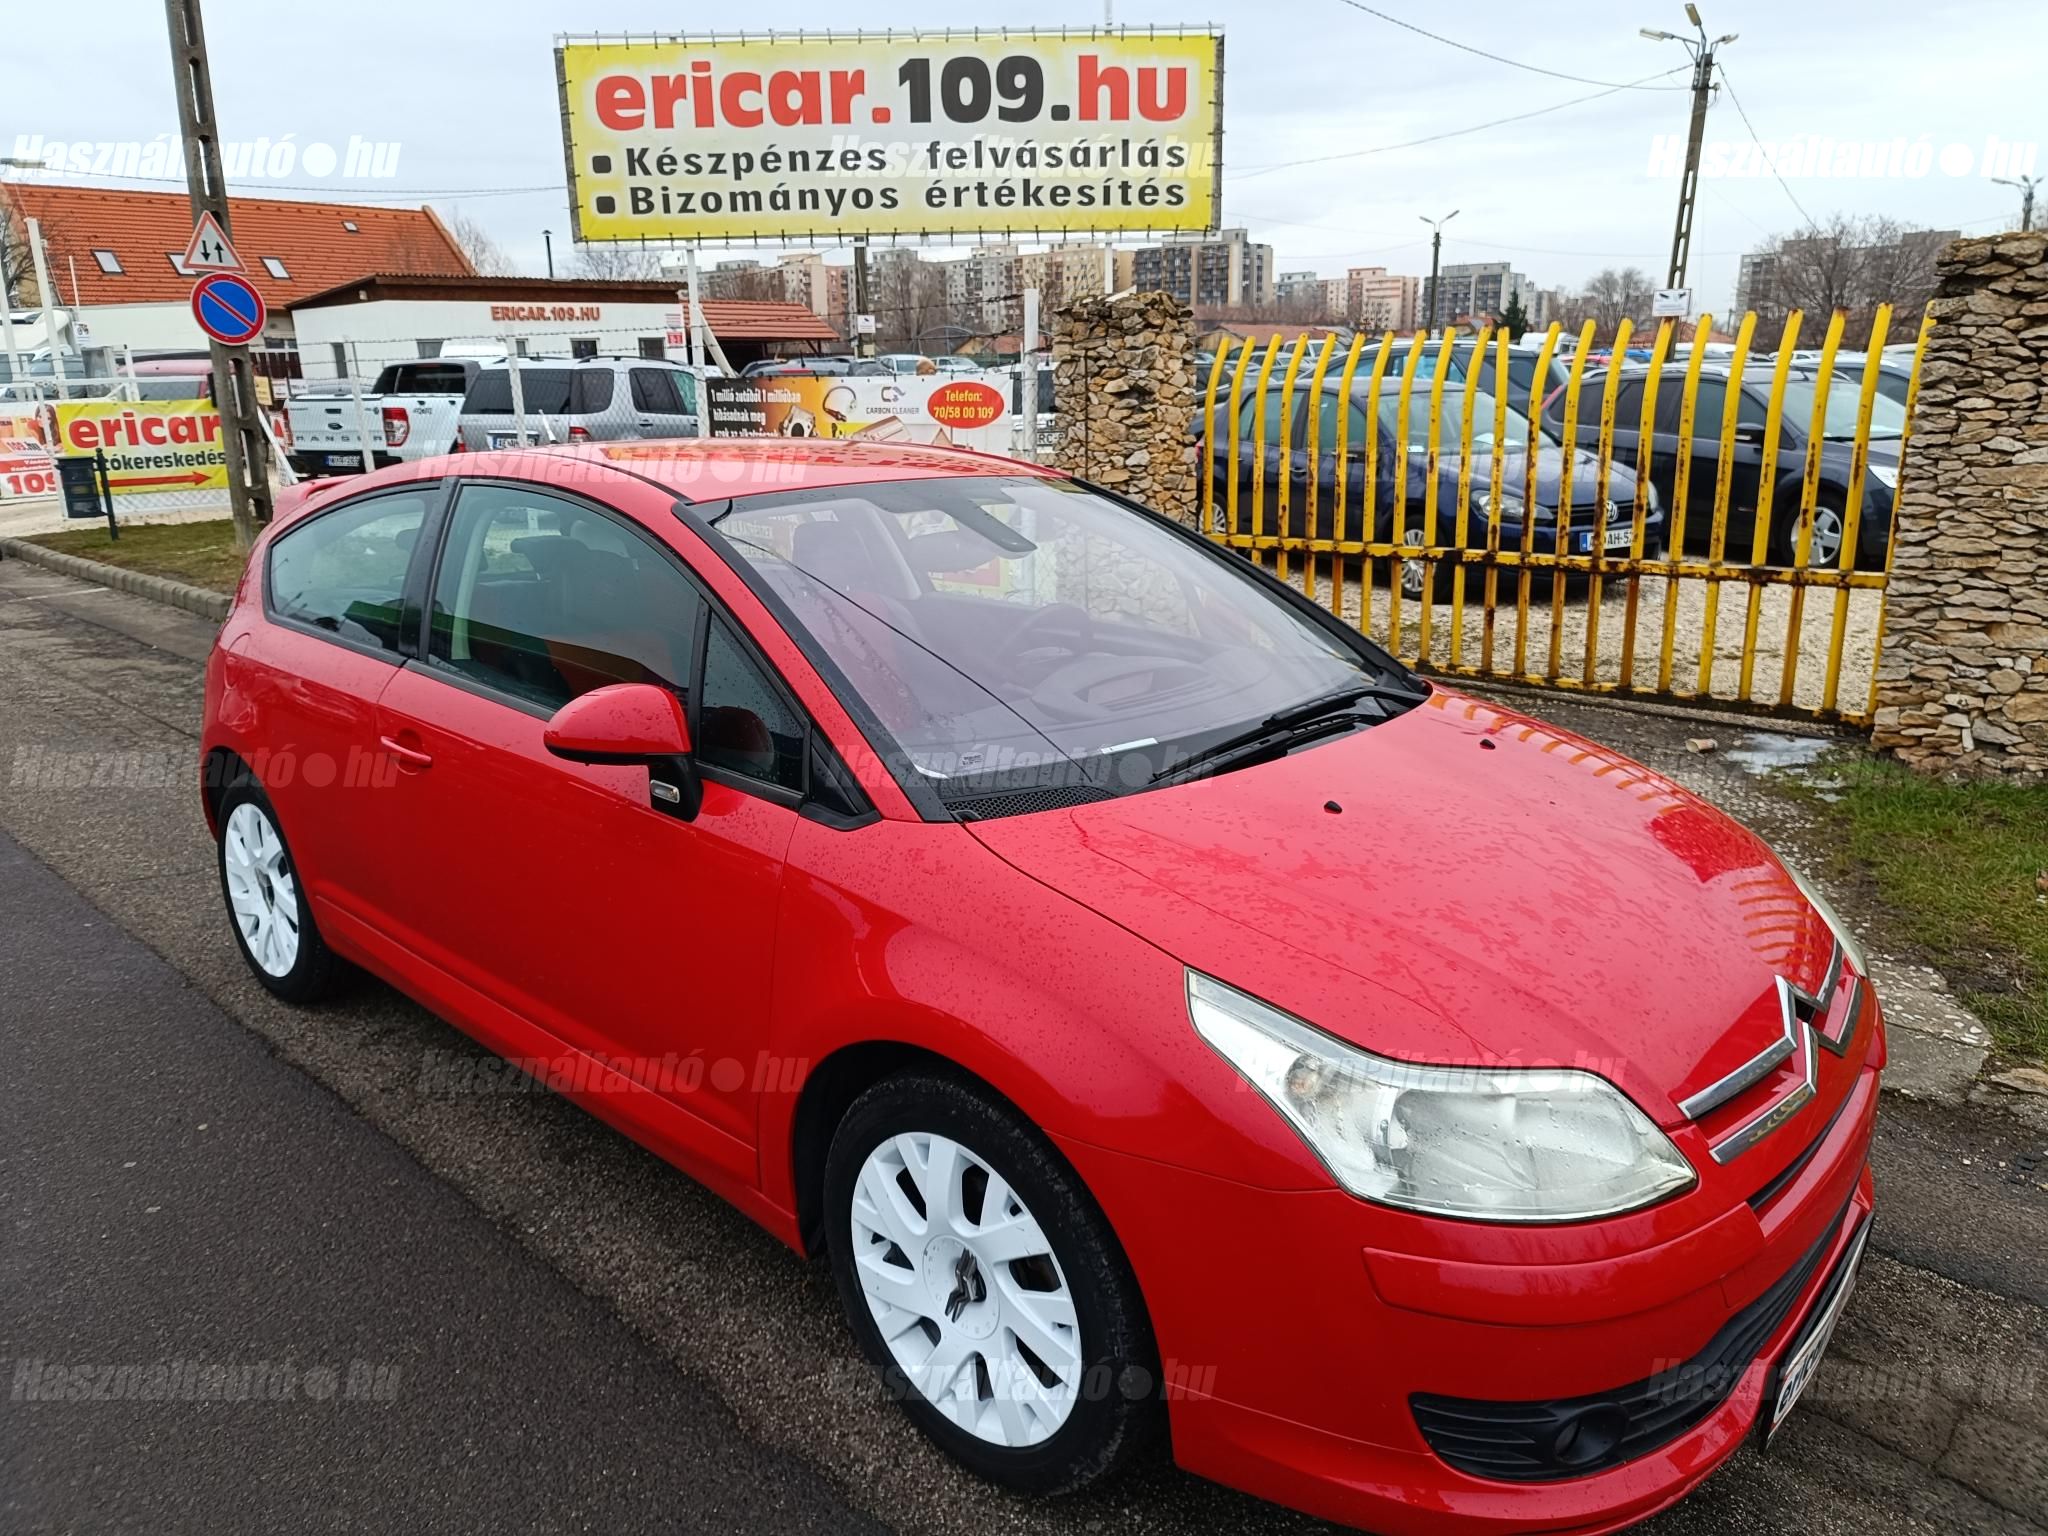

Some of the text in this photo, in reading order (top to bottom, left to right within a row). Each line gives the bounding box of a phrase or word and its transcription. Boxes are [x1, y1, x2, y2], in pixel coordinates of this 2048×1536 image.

[594, 53, 1188, 131] ericar.109.hu
[626, 137, 1186, 181] Készpénzes felvásárlás
[630, 178, 1185, 217] Bizományos értékesítés
[490, 305, 600, 322] ERICAR.109.HU
[944, 390, 982, 402] Telefon:
[892, 407, 920, 415] CLEANER
[933, 406, 994, 419] 70/58 00 109
[68, 411, 222, 449] ericar
